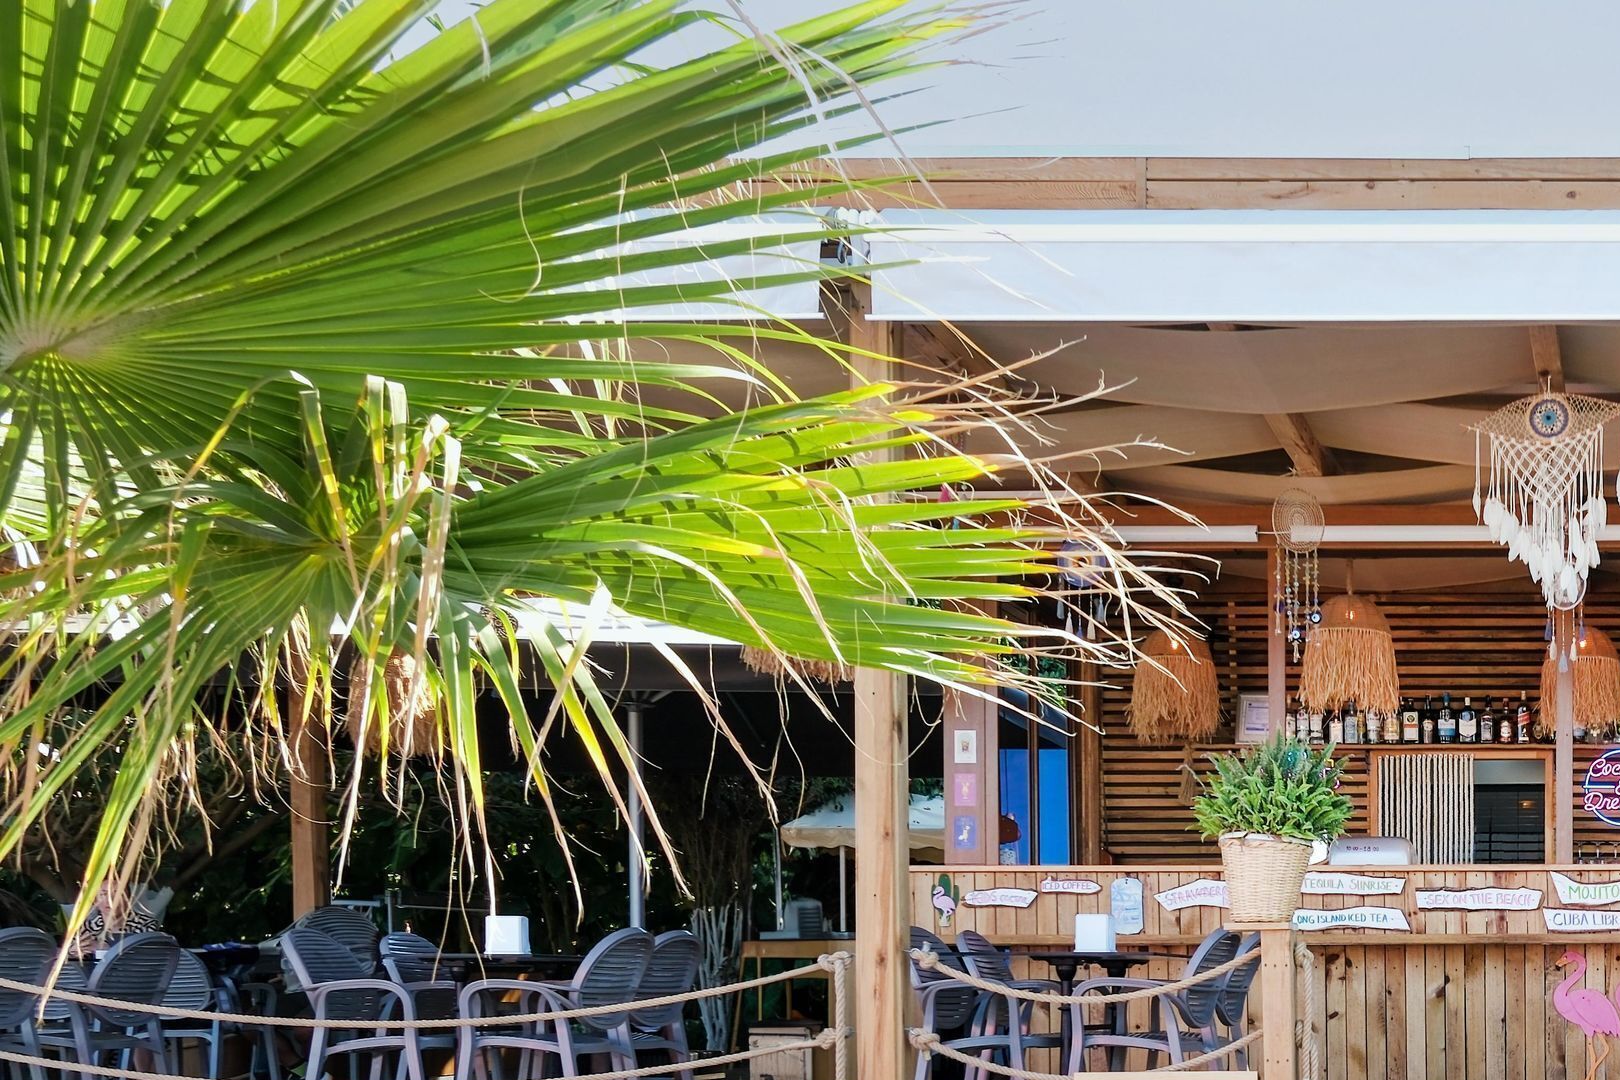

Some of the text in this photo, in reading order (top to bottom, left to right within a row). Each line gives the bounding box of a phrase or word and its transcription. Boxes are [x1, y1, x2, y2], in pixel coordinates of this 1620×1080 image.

[1062, 881, 1092, 890] COFFEE
[1303, 878, 1392, 891] TEQUILA SUNRISE
[1568, 885, 1620, 899] MOJITO
[1426, 893, 1532, 906] SEX ON THE BEACH
[1297, 914, 1315, 924] ONG
[1317, 913, 1346, 924] ISLAND
[1369, 914, 1388, 923] TEA
[1553, 913, 1588, 926] CUBA
